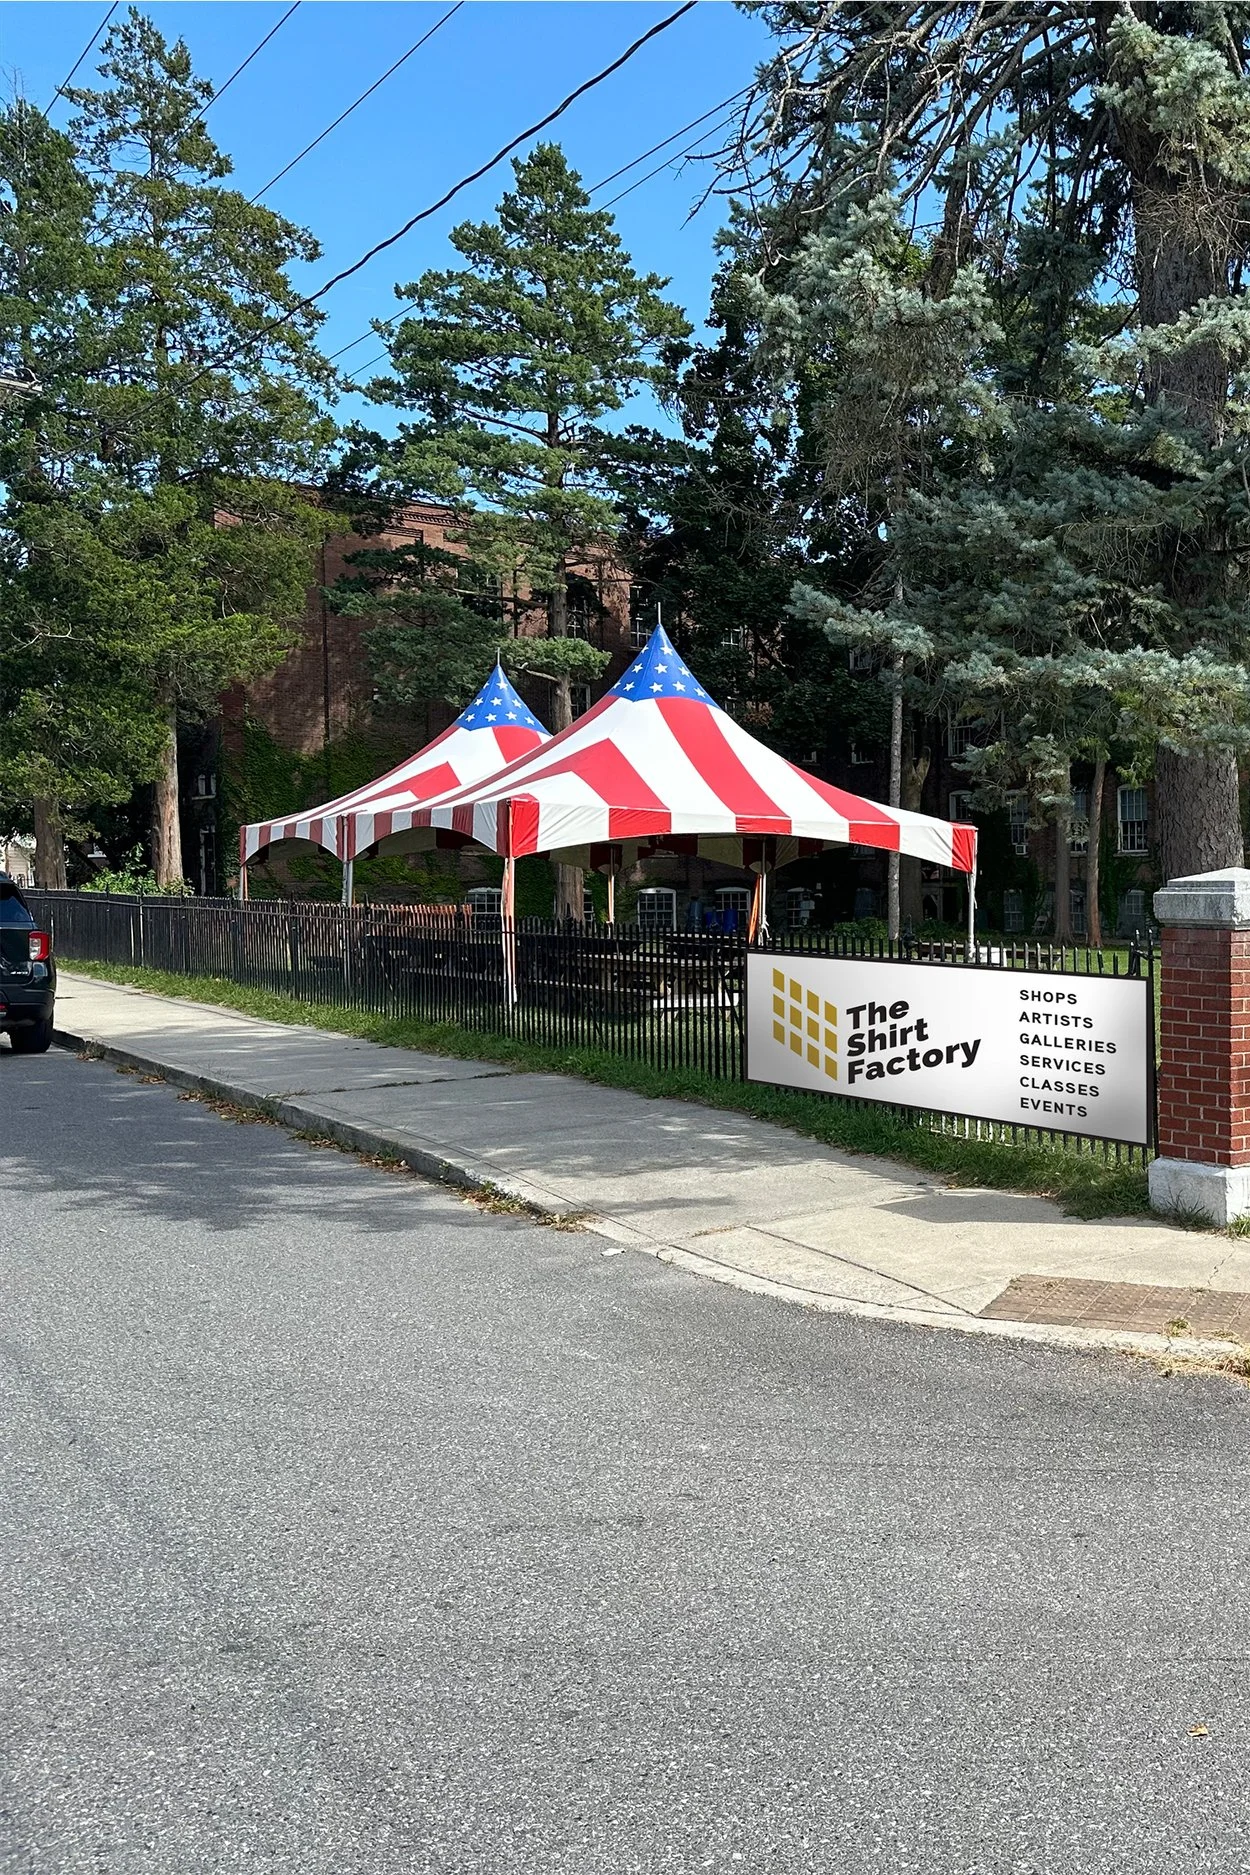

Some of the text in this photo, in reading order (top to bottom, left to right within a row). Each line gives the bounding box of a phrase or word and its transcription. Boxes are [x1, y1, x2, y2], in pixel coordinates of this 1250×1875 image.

[1018, 989, 1078, 1005] SHOPS
[846, 1000, 910, 1030] The
[1018, 1012, 1093, 1029] ARTISTS
[846, 1017, 929, 1057] Shirt
[1018, 1033, 1117, 1054] GALLERIES
[847, 1038, 982, 1085] Factory
[1018, 1054, 1106, 1076] SERVICES
[1018, 1076, 1100, 1098] CLASSES
[1019, 1097, 1088, 1118] EVENTS
